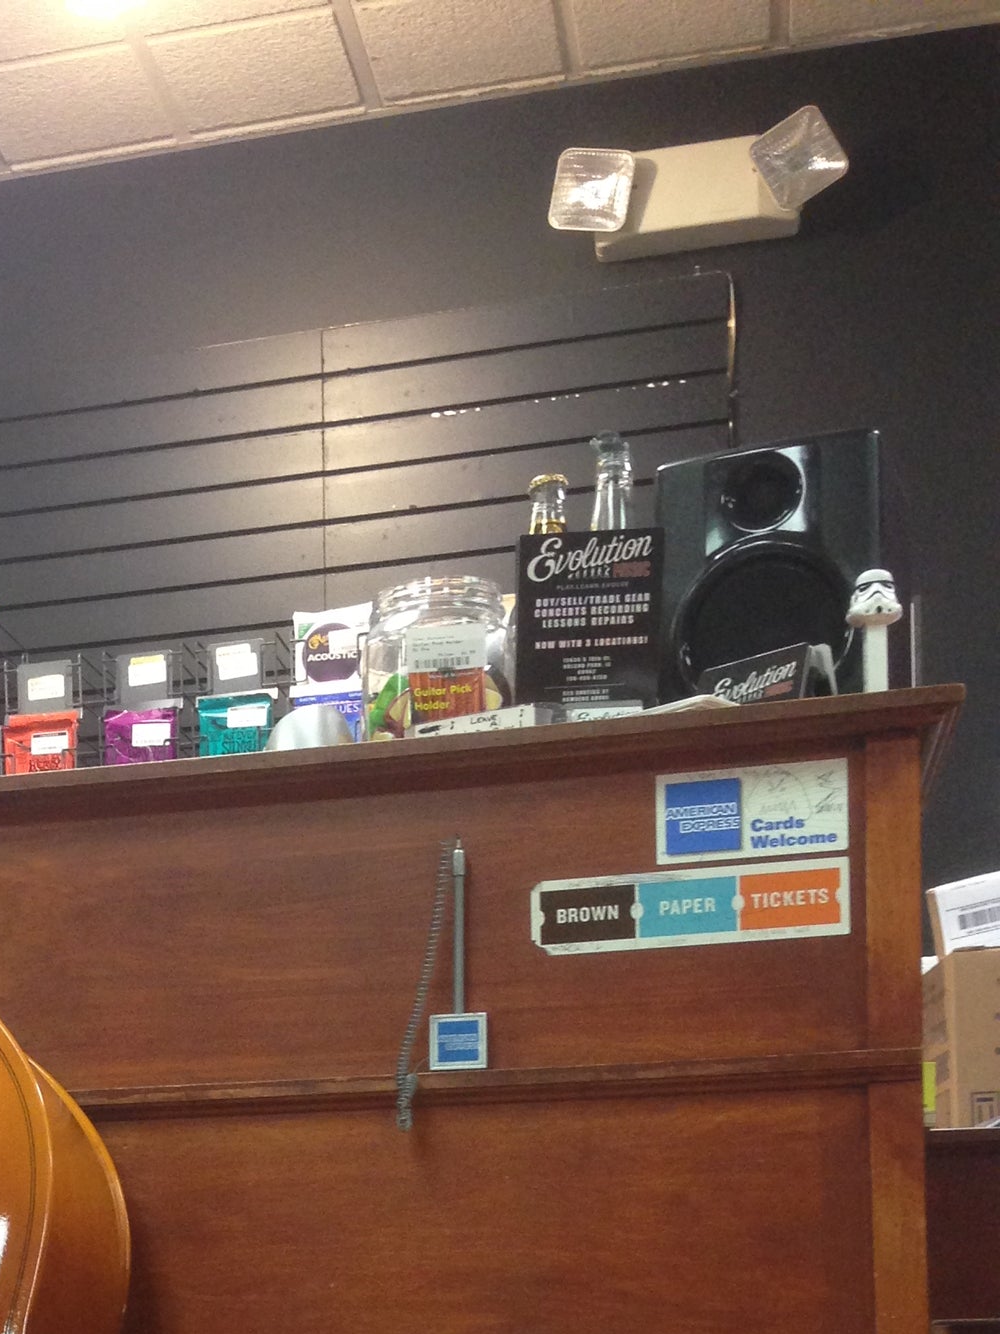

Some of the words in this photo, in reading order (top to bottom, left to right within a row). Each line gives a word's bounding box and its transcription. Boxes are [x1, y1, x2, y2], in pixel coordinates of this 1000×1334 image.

[527, 535, 653, 582] Evolution
[534, 607, 586, 617] CONCERTS
[590, 604, 649, 615] RECORDING
[542, 618, 586, 628] LESSONS
[591, 615, 634, 626] REPAIRS
[308, 652, 357, 662] ACOUSTIC
[713, 661, 797, 700] Evolution
[414, 688, 446, 696] Guitar
[450, 684, 472, 694] Pick
[415, 702, 450, 710] Holder
[666, 802, 736, 820] AMERICAN
[680, 816, 740, 833] EXPRESS
[750, 816, 805, 832] Cards
[750, 832, 837, 849] Welcome
[556, 904, 619, 924] BROWN
[659, 897, 716, 916] PAPER
[751, 889, 829, 909] TICKETS
